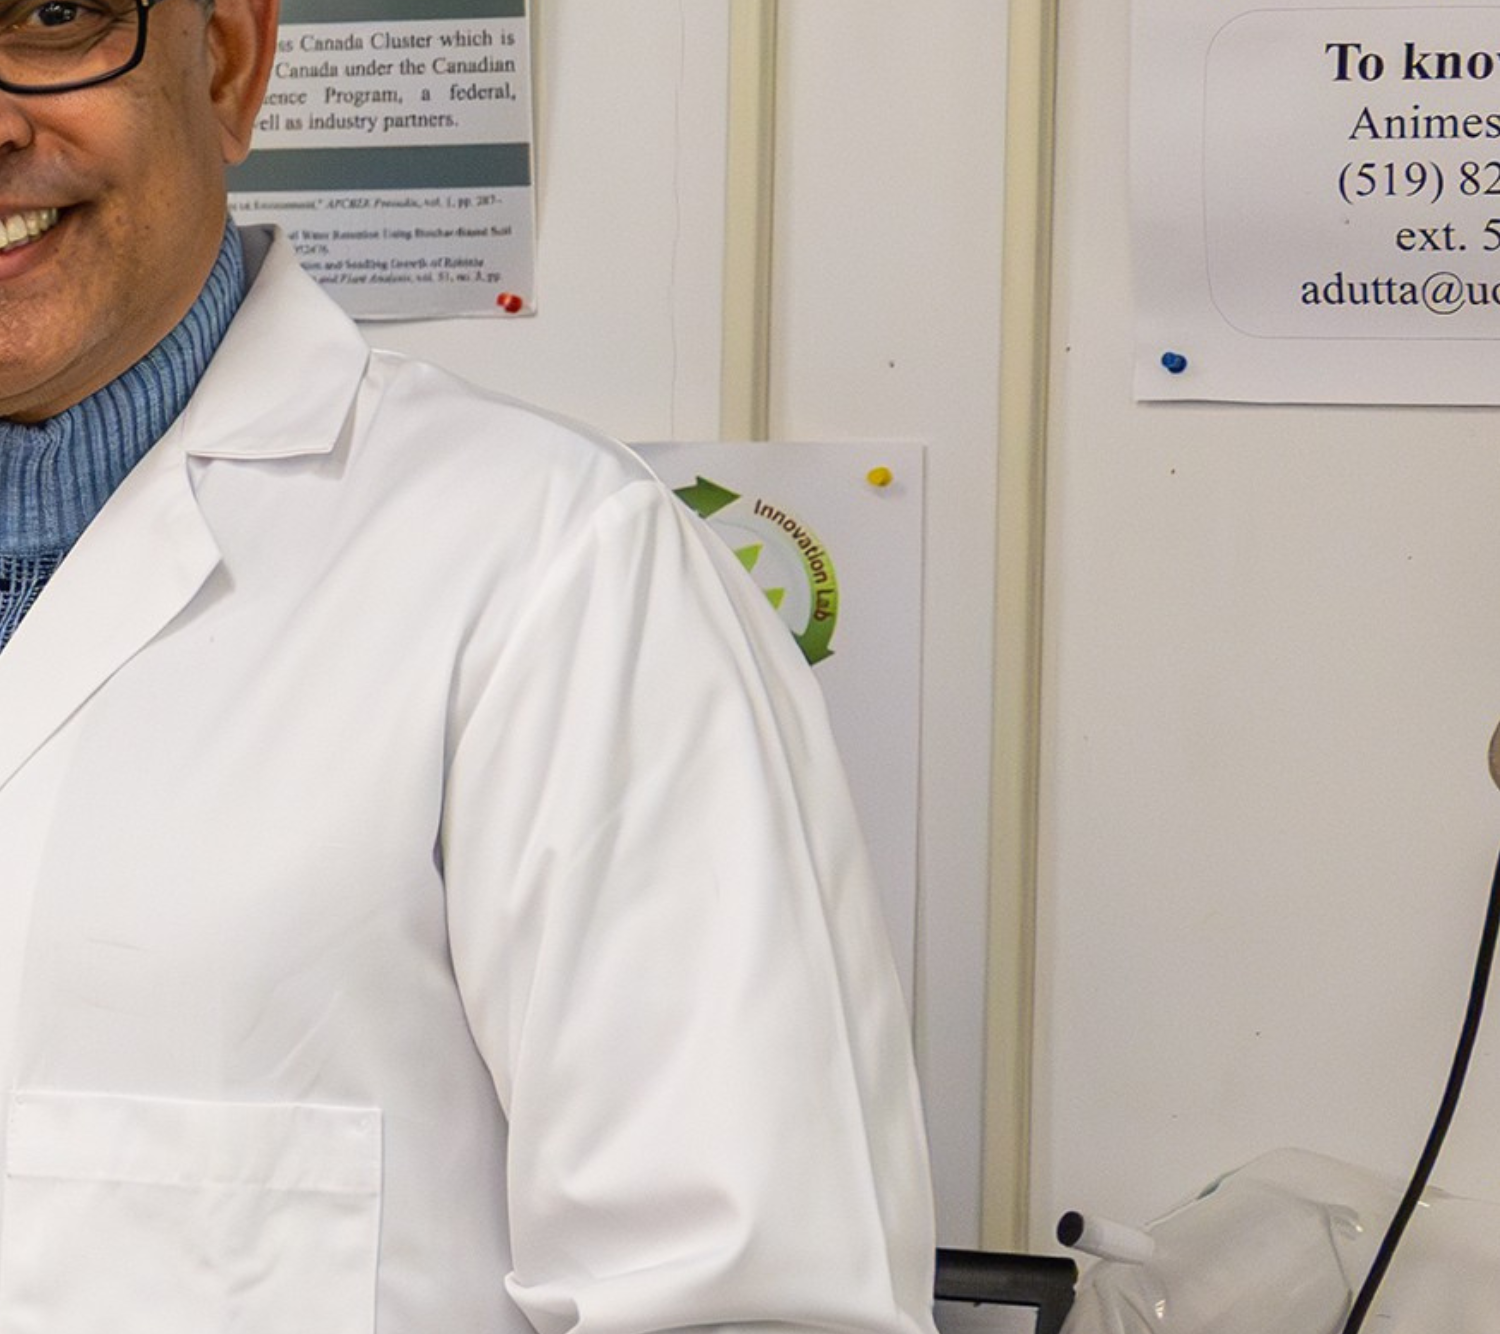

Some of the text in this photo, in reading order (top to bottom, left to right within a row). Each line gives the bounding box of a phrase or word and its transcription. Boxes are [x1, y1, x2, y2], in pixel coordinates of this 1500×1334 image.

[300, 26, 515, 52] Canada Cluster which is
[275, 55, 516, 79] Canada under the Canadian
[1325, 42, 1500, 82] To kno
[1350, 104, 1500, 139] Animes
[1339, 162, 1500, 204] (519) 82
[1396, 222, 1466, 251] ext.
[754, 498, 834, 621] Innovation Lab
